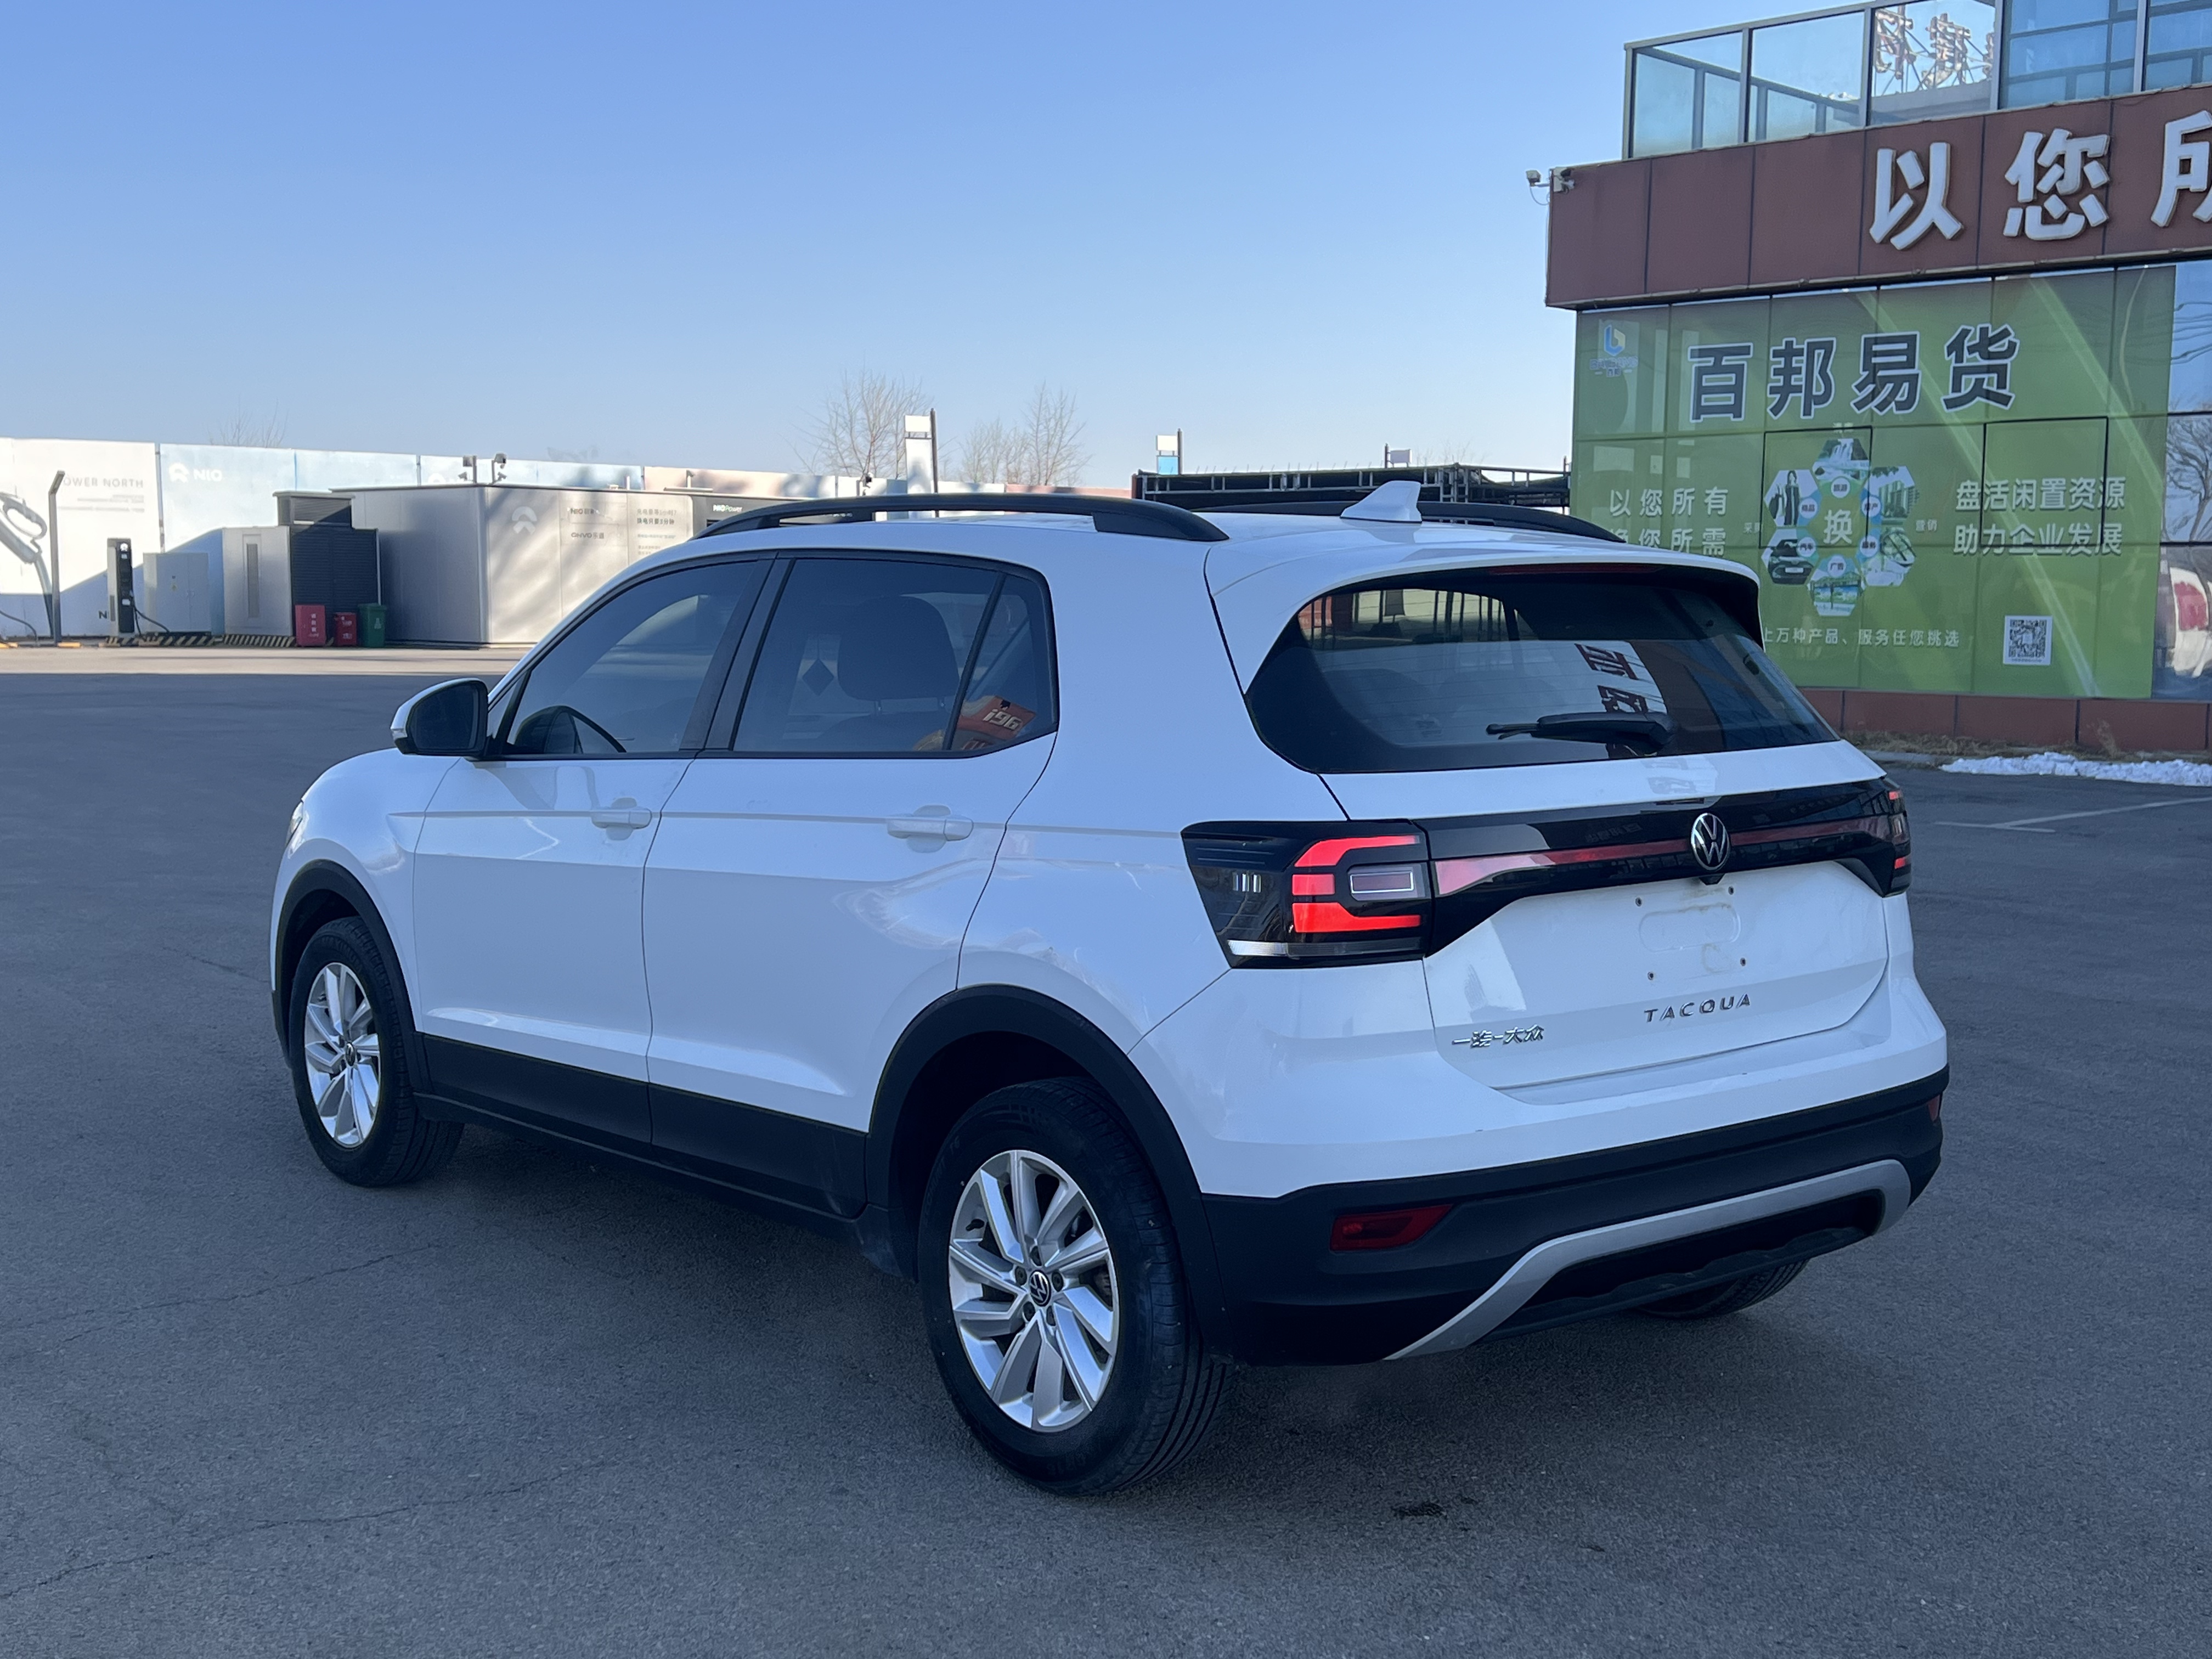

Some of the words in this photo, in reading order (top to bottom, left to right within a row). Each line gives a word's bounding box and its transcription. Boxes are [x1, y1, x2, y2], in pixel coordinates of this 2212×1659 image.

[1688, 324, 2020, 422] 百邦易货
[63, 477, 98, 487] OWER
[103, 478, 144, 488] NORTH
[193, 469, 223, 482] NIO
[1610, 486, 1728, 517] 以您所有
[1956, 477, 2126, 511] 盘活闲置资源
[1823, 509, 1853, 544] 换
[1953, 523, 2123, 555] 助力企业发展
[1644, 992, 1750, 1022] TACQUA
